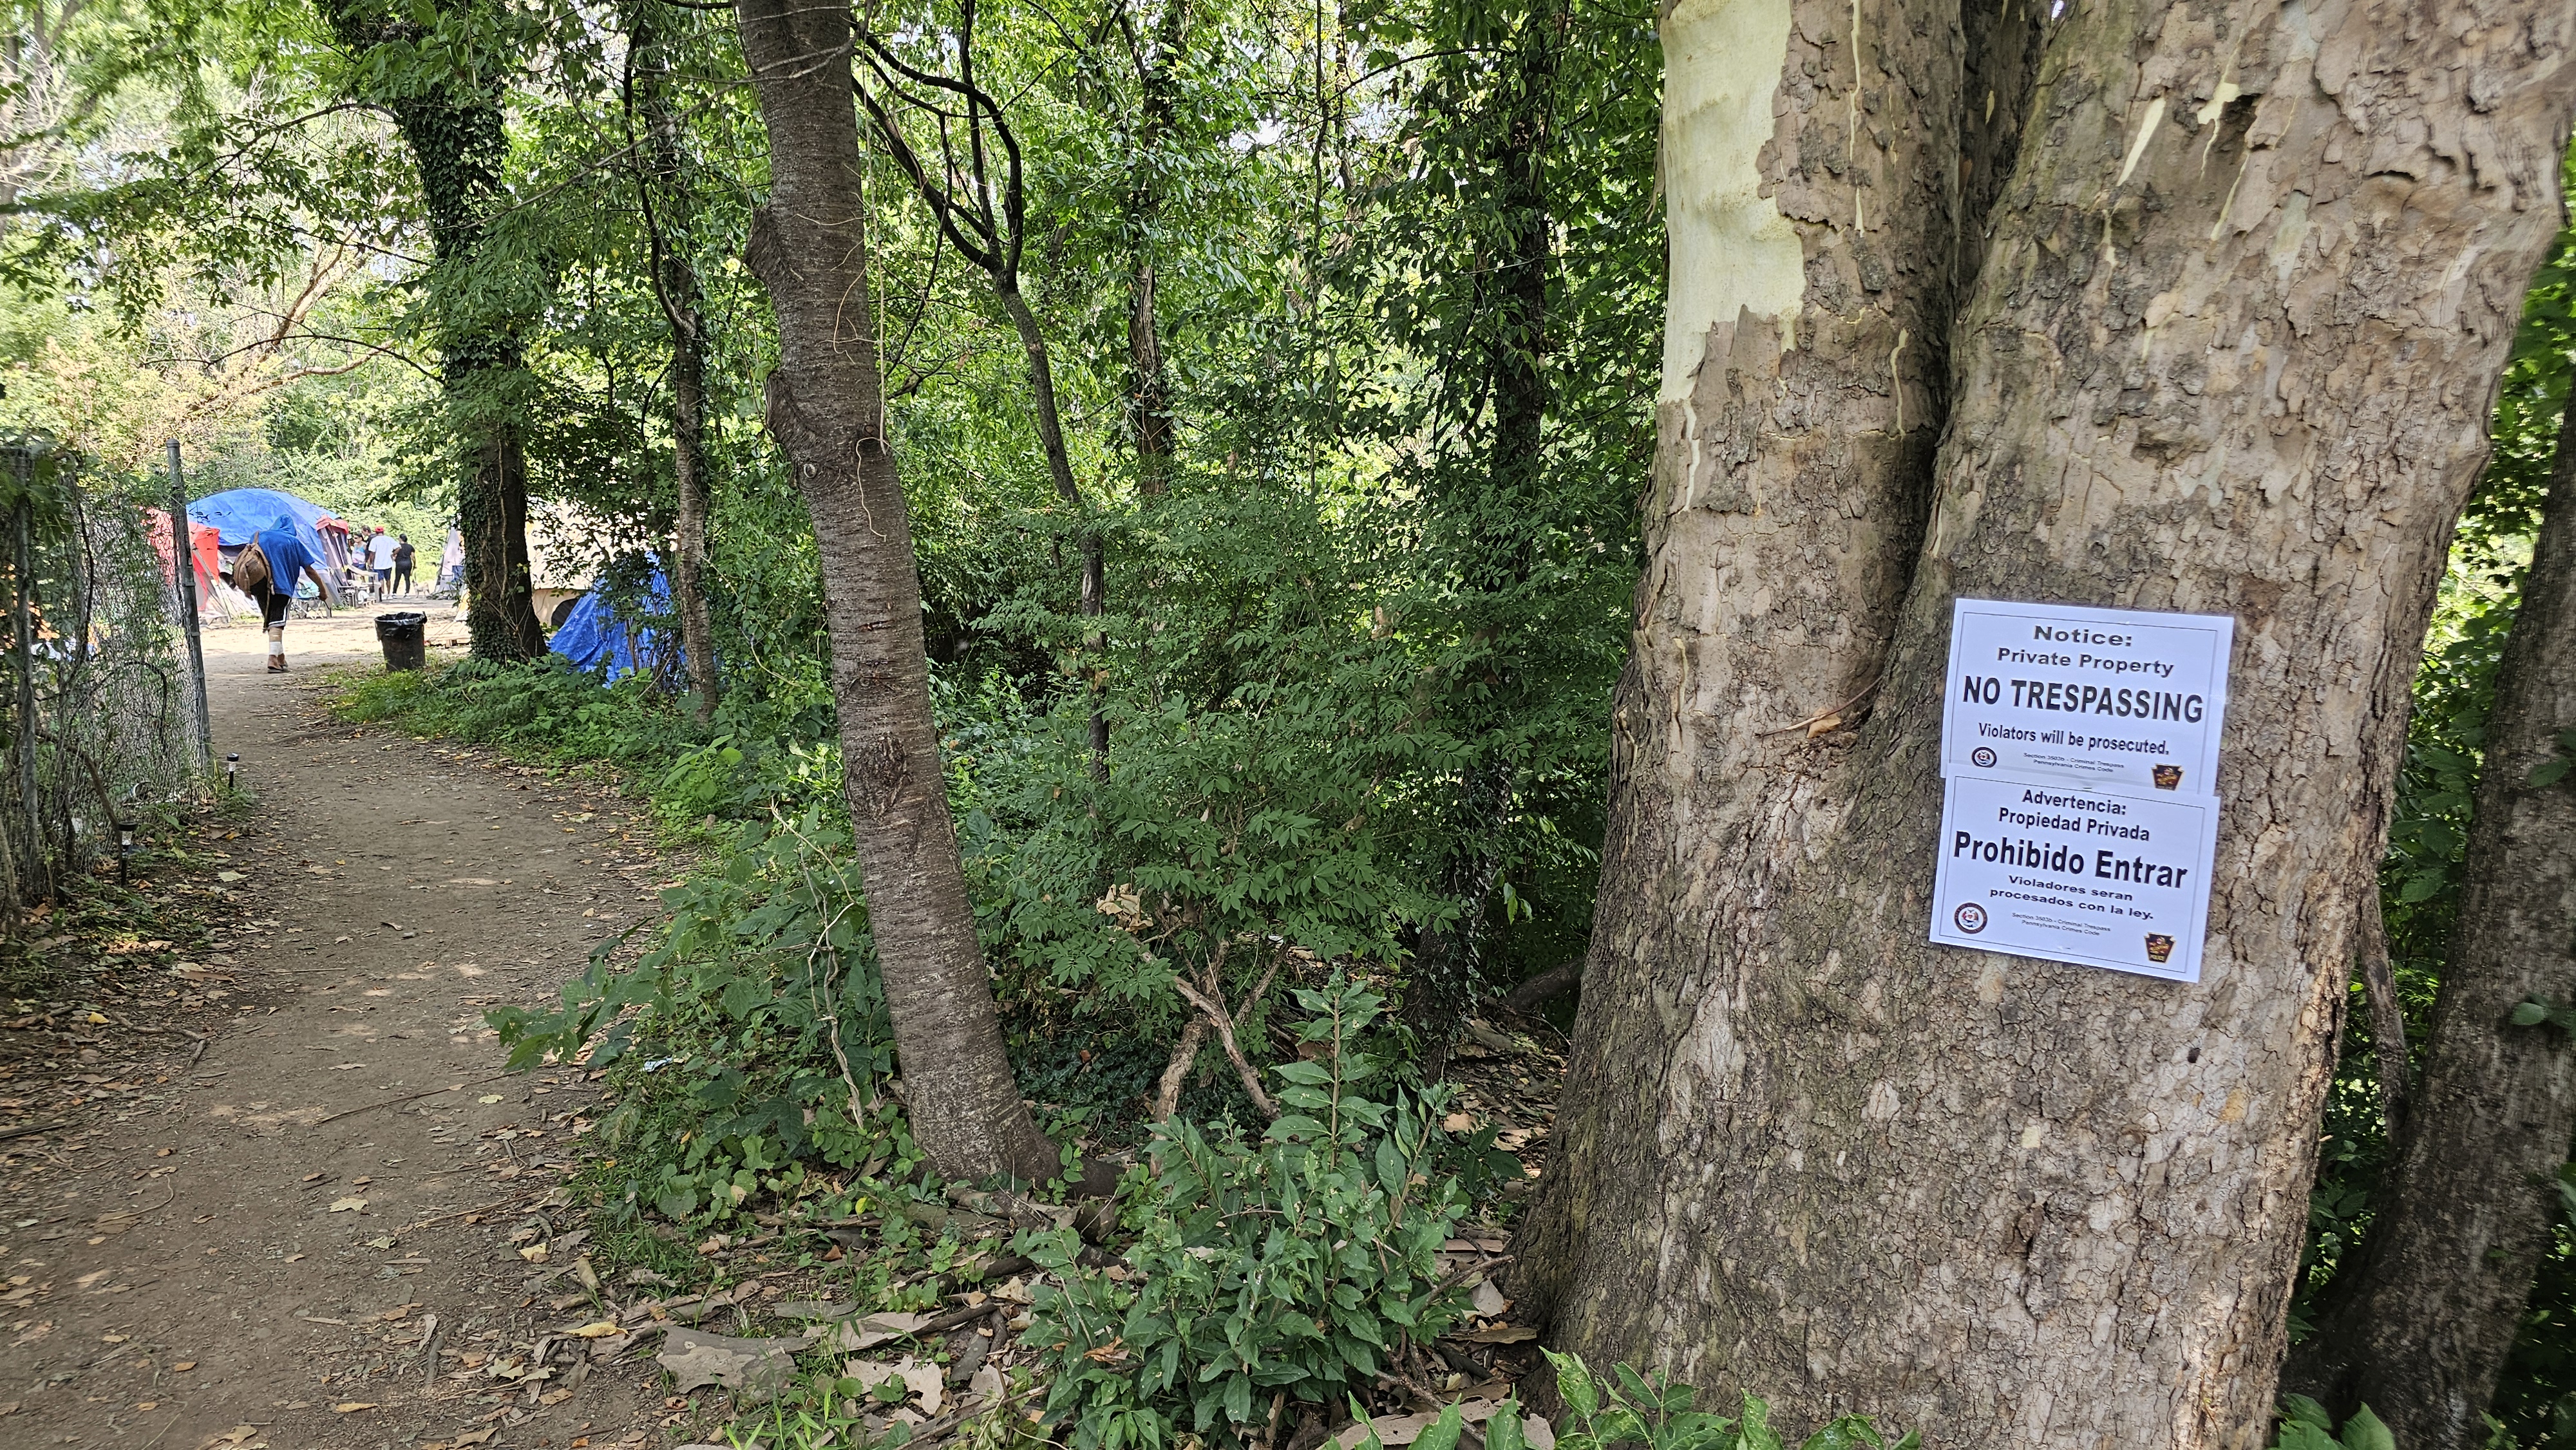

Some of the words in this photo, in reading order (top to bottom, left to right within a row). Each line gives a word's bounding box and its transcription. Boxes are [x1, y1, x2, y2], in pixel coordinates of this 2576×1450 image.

[2033, 626, 2132, 646] Notice:
[1997, 648, 2071, 666] Private
[2079, 654, 2174, 678] Property
[1963, 675, 2001, 704] NO
[2011, 679, 2203, 724] TRESPASSING
[1978, 722, 2036, 741] Violators
[2041, 730, 2064, 744] will
[2068, 732, 2083, 746] be
[2088, 735, 2170, 755] prosecuted.
[2033, 759, 2073, 768] Pennsylvania
[2022, 789, 2126, 816] Advertencia:
[1999, 807, 2080, 832] Propiedad
[2087, 819, 2150, 841] Privada
[1954, 831, 2084, 874] Prohibido
[2095, 850, 2188, 889] Entrar
[2008, 875, 2086, 894] Violadores
[2091, 889, 2133, 901] seran
[1990, 888, 2073, 908] procesados
[2078, 901, 2105, 912] con
[2110, 905, 2123, 916] la
[2128, 907, 2154, 919] ley.
[2022, 919, 2060, 929] Pennsylvania
[2058, 919, 2082, 927] Criminal
